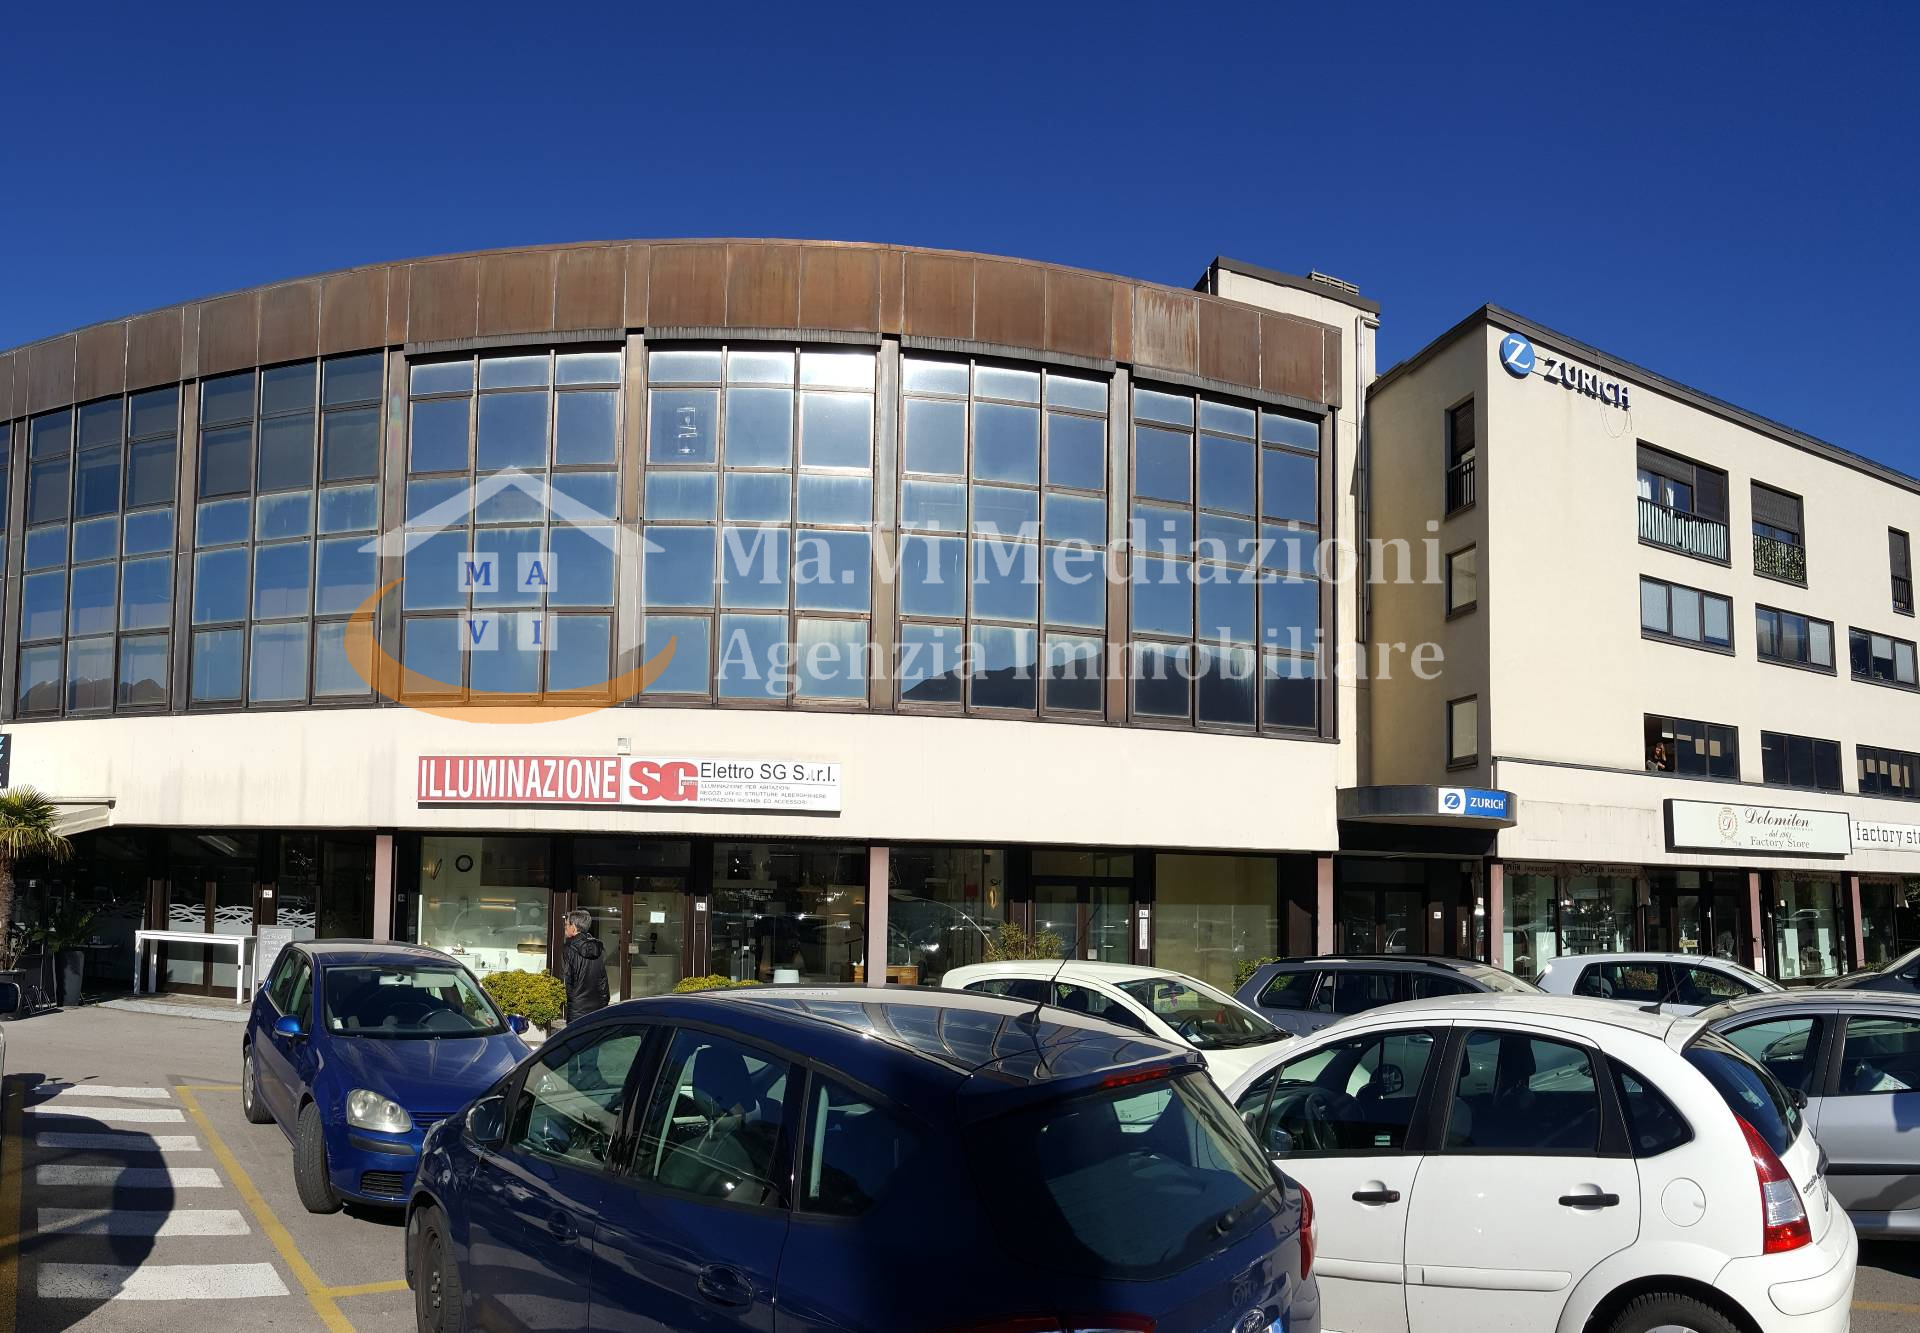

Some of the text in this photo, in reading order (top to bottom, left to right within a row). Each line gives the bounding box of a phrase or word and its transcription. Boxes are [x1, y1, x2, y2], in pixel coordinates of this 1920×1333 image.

[1544, 357, 1631, 409] ZURICH
[420, 758, 617, 799] ILLUMINAZIONE
[629, 761, 699, 801] SG
[701, 762, 754, 779] Elettro
[760, 763, 787, 780] SG
[1470, 797, 1505, 810] ZURICH
[1745, 808, 1809, 827] Dolomiten
[1750, 836, 1811, 849] Factory Store
[1856, 822, 1920, 847] factory st
